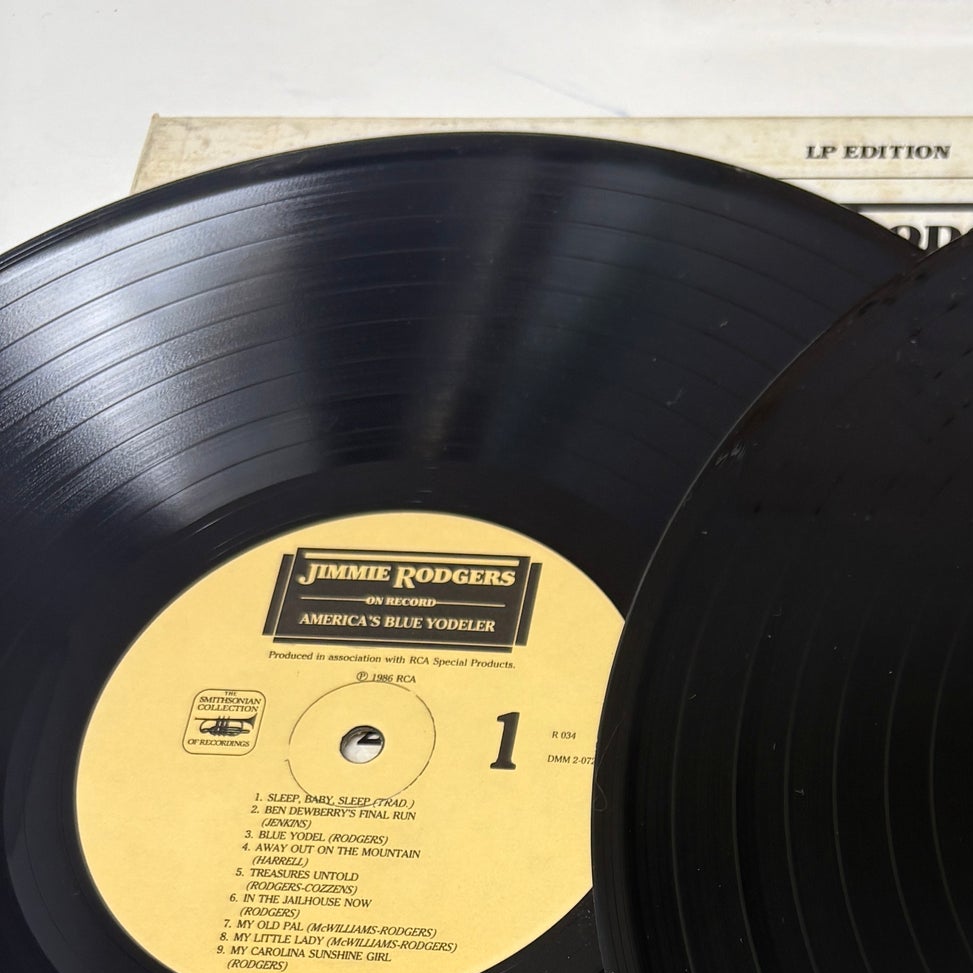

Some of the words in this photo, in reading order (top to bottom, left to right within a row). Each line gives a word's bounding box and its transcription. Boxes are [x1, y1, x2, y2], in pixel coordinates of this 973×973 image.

[806, 145, 838, 159] LP
[843, 145, 951, 159] EDITION
[297, 563, 391, 586] JIMMIE
[392, 565, 516, 589] RODGERS
[365, 596, 385, 606] ON
[386, 597, 437, 607] RECORD
[299, 613, 381, 627] AMERICA'S
[384, 616, 423, 629] BLUE
[426, 617, 496, 632] YODELER
[268, 650, 314, 660] Produced
[316, 652, 326, 661] in
[328, 654, 382, 663] association
[385, 655, 406, 664] with
[409, 656, 429, 665] RCA
[433, 657, 468, 667] Special
[470, 658, 515, 669] Products.
[490, 711, 520, 770] 1
[552, 731, 559, 739] R
[560, 731, 576, 740] 034
[547, 754, 571, 764] DMM
[250, 804, 260, 814] 2.
[264, 805, 287, 815] BEN
[289, 806, 356, 818] DEWBERRY'S
[359, 809, 390, 820] FINAL
[392, 811, 416, 820] RUN
[261, 818, 312, 830] (JENKINS)
[244, 829, 253, 839] 3.
[258, 830, 287, 840] BLUE
[290, 831, 326, 842] YODEL
[328, 833, 389, 846] (RODGERS)
[241, 842, 251, 851] 4.
[255, 843, 288, 853] AWAY
[290, 844, 315, 854] OUT
[317, 845, 334, 855] ON
[337, 846, 359, 856] THE
[361, 847, 421, 859] MOUNTAIN
[252, 855, 309, 868] (HARRELL)
[235, 867, 244, 877] 5.
[250, 868, 310, 879] TREASURES
[313, 871, 359, 881] UNTOLD
[246, 881, 358, 896] (RODGERS-COZZENS)
[229, 893, 238, 902] 6.
[243, 893, 256, 903] IN
[258, 894, 280, 904] THE
[282, 895, 342, 907] JAILHOUSE
[344, 898, 372, 908] NOW
[239, 906, 300, 920] (RODGERS)
[224, 918, 232, 928] 7.
[236, 919, 255, 929] MY
[257, 920, 280, 930] OLD
[282, 921, 304, 931] PAL
[306, 923, 437, 939] (McWILLIAMS-RODGERS)
[216, 944, 225, 954] 9.
[230, 945, 249, 955] MY
[250, 946, 305, 958] CAROLINA
[308, 949, 363, 961] SUNSHINE
[366, 952, 392, 962] GIRL
[227, 959, 288, 972] (RODGERS)
